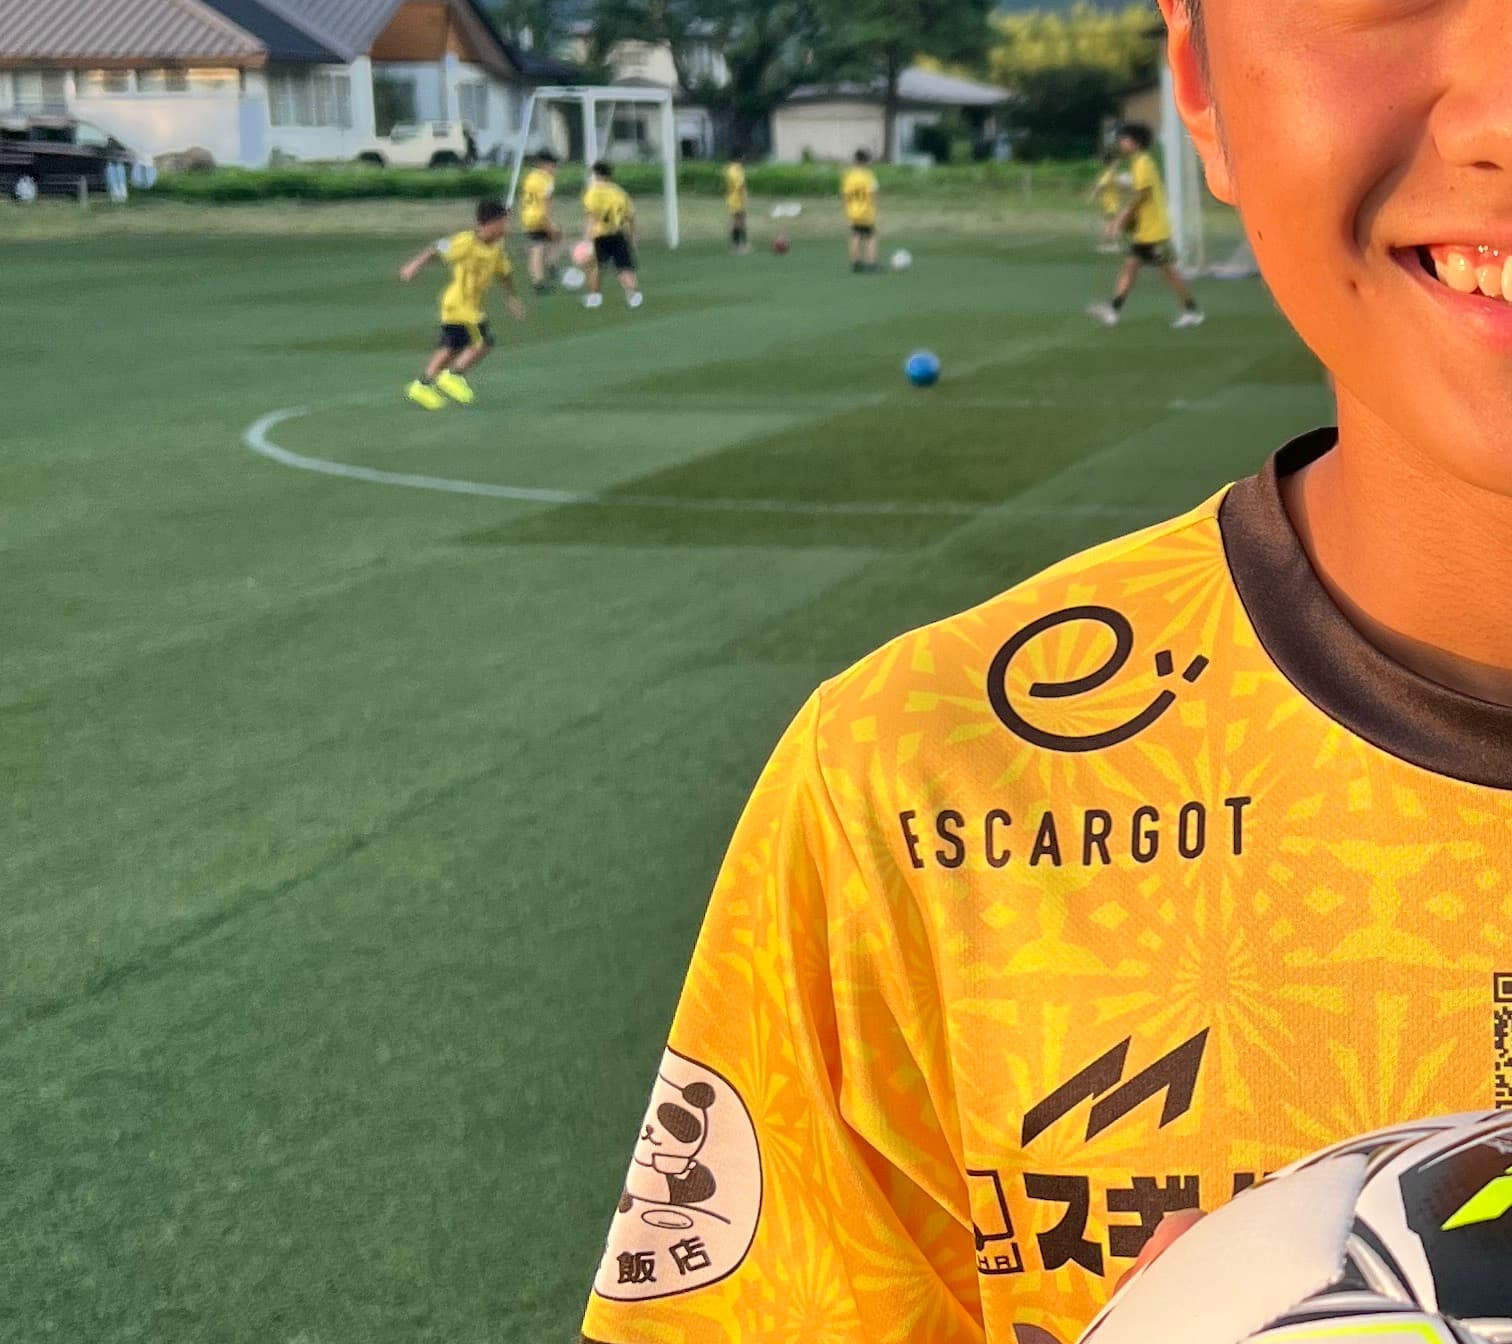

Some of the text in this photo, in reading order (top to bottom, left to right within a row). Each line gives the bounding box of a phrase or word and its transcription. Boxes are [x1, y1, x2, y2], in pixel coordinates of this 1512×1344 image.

[899, 796, 1252, 869] ESCARGOT
[616, 1236, 713, 1284] 飯店
[1023, 1171, 1270, 1278] スギ
